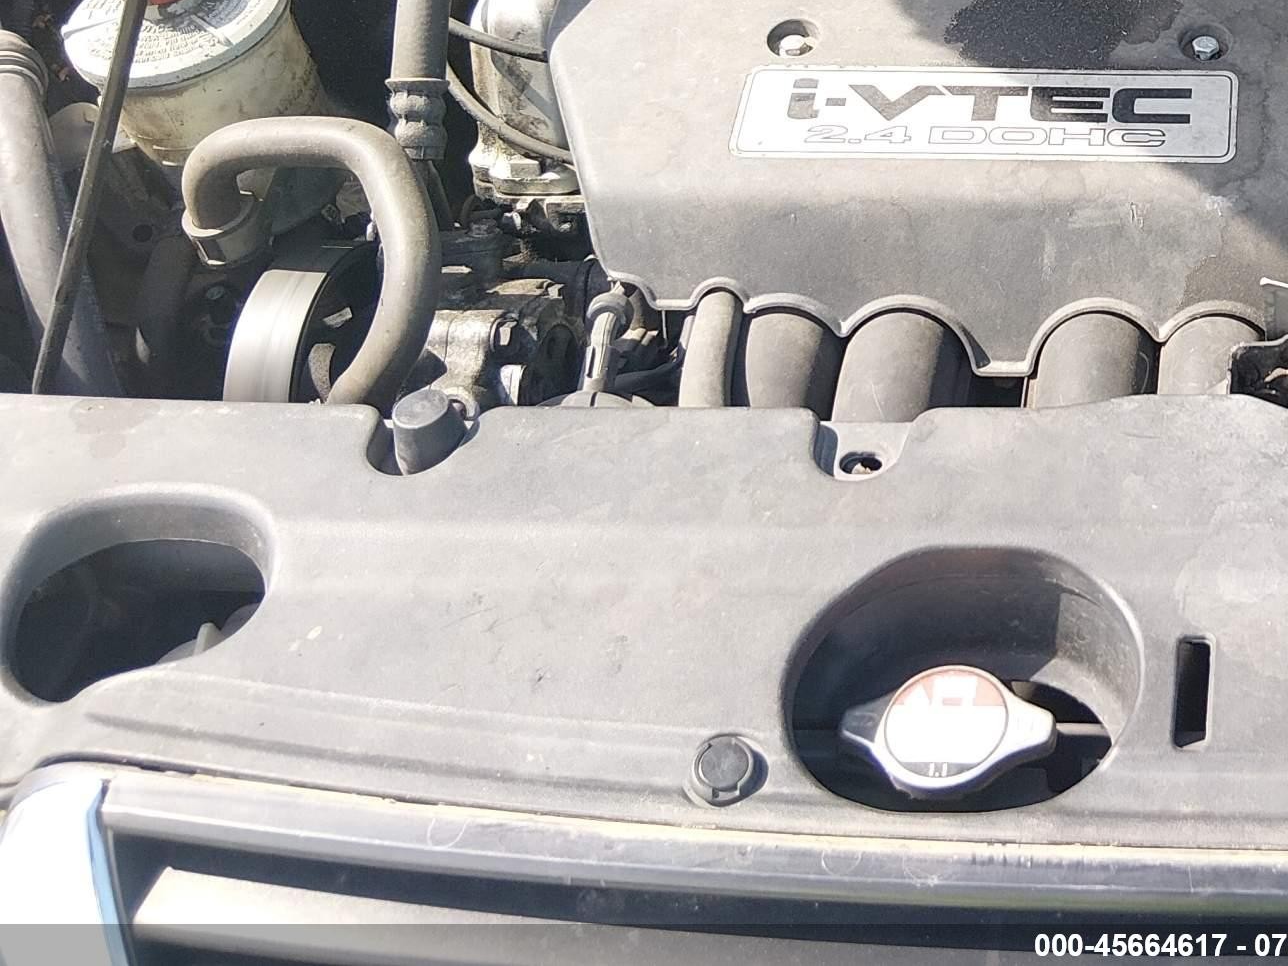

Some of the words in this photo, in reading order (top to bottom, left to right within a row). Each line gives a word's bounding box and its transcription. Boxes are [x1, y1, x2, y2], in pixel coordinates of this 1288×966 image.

[787, 78, 1192, 123] i-VTEC
[804, 125, 911, 145] 2.4
[928, 127, 1166, 147] DOHC
